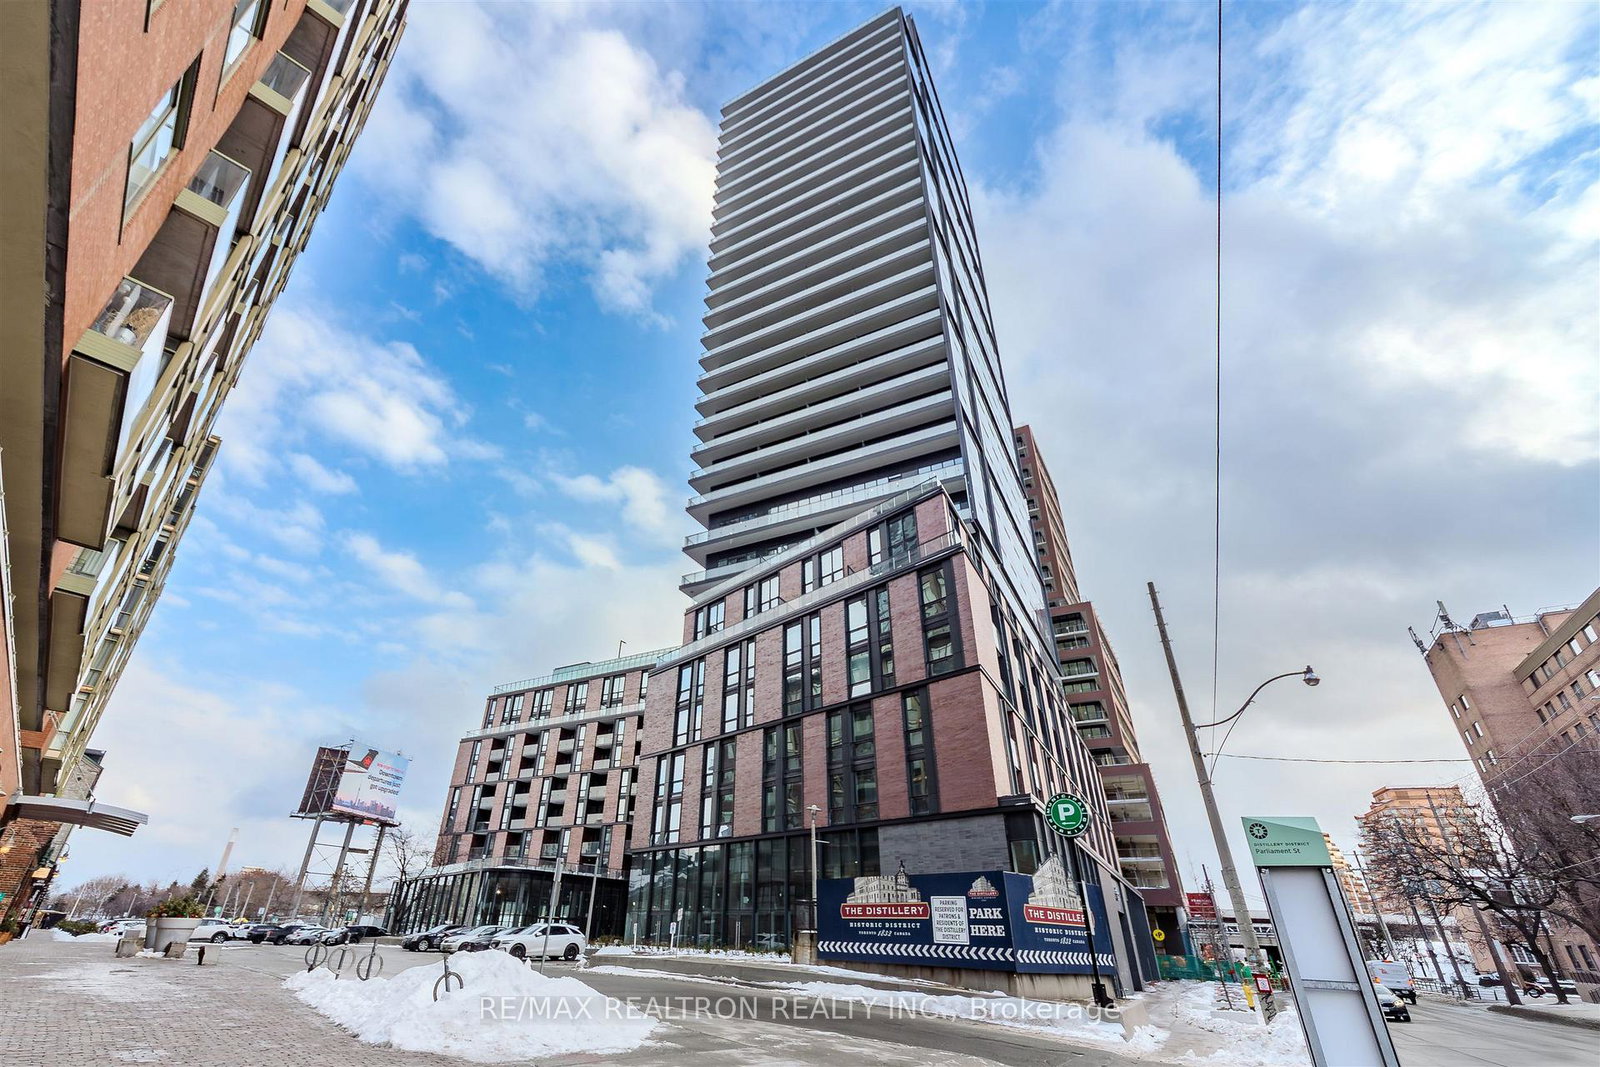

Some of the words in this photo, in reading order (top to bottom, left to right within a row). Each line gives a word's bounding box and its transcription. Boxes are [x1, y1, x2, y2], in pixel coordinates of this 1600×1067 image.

[1057, 803, 1075, 821] P
[844, 907, 863, 915] THE
[866, 906, 924, 915] DISTILLERY
[968, 907, 1003, 919] PARK
[1028, 909, 1045, 919] THE
[969, 925, 1006, 937] HERE
[1034, 927, 1063, 935] HISTORIC
[1064, 929, 1088, 937] DISTRIC
